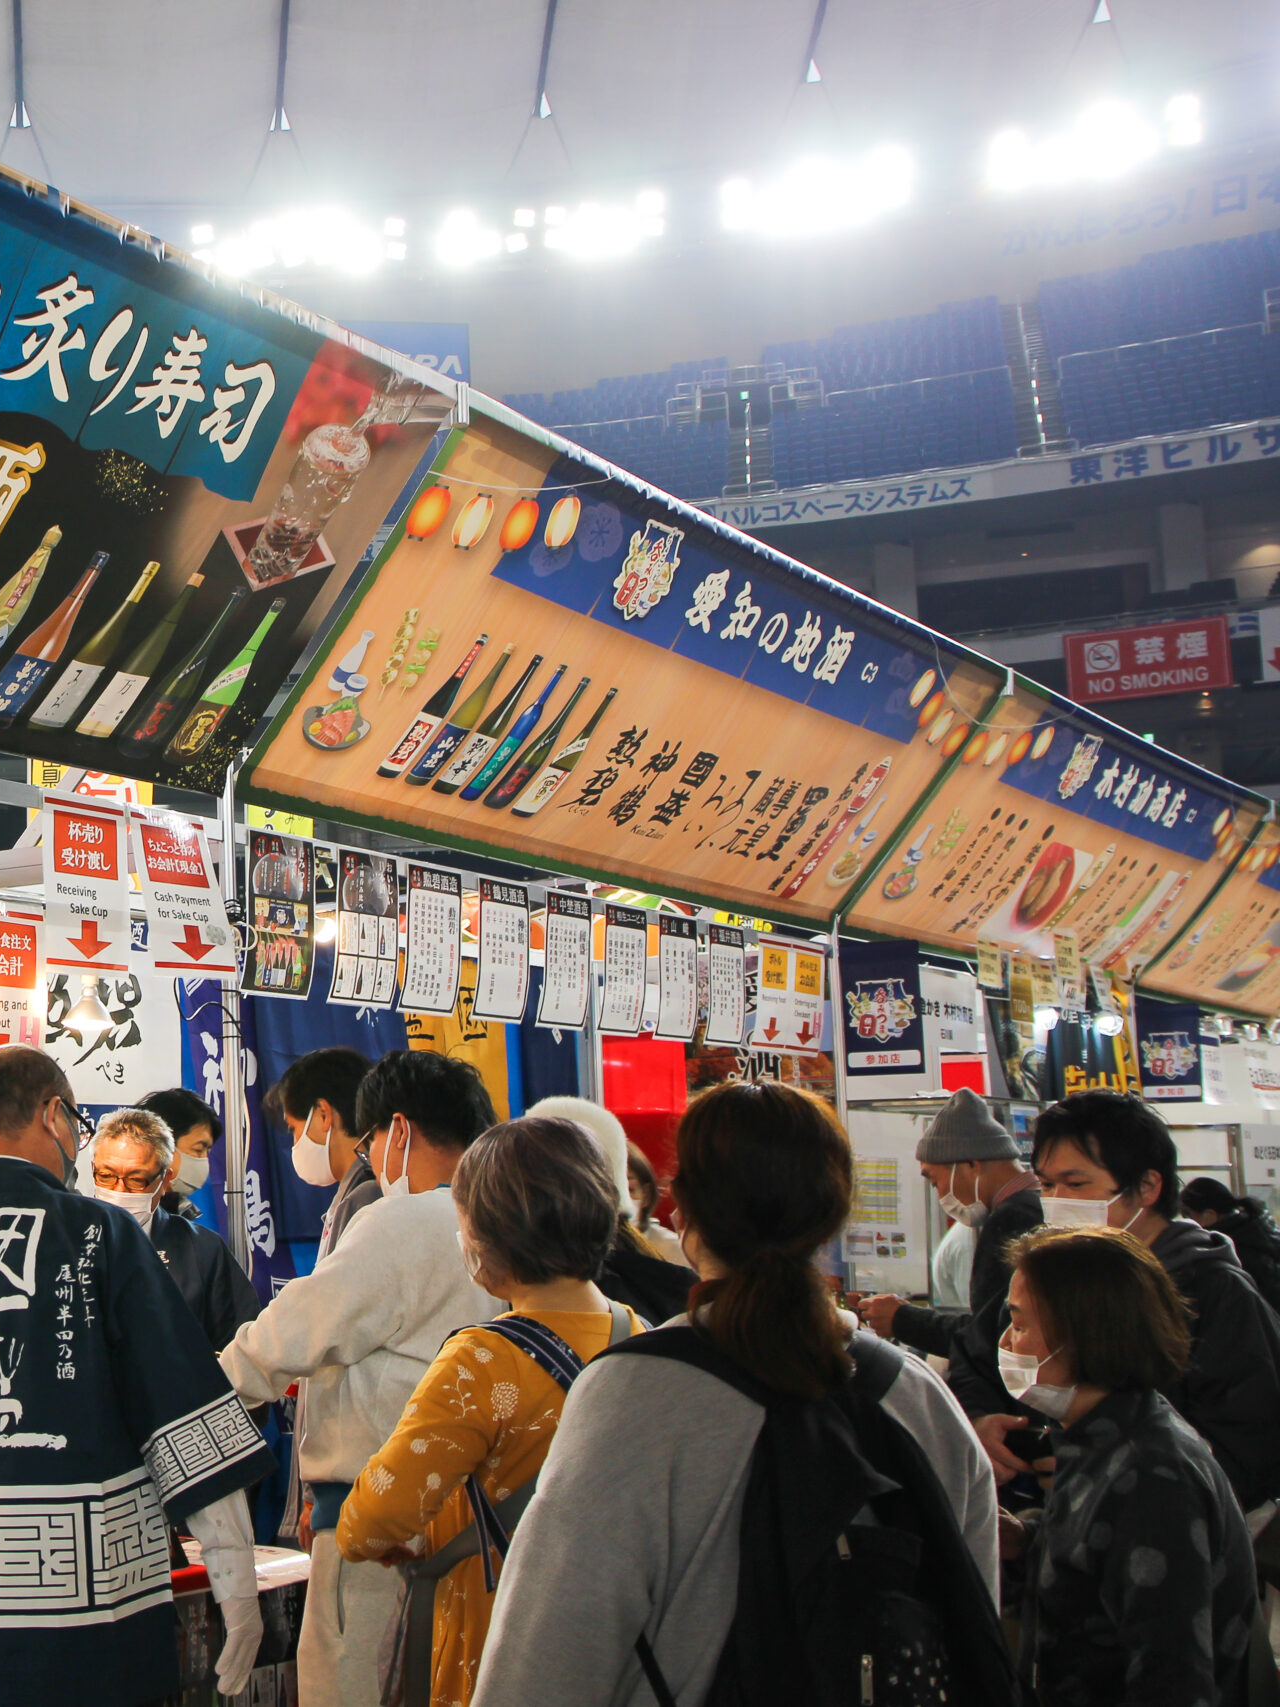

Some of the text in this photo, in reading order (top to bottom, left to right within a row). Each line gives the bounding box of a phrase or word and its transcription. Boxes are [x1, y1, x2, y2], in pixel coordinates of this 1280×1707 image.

[720, 477, 973, 526] パルコスペースシステムズ
[684, 568, 879, 686] 愛知の地酒 C3
[1132, 629, 1209, 666] 禁煙
[1089, 666, 1210, 694] NO SMOKING
[607, 740, 683, 827] 神鶴
[648, 750, 720, 826] 國盛
[67, 820, 104, 843] 杯売り
[60, 849, 112, 871] 受け渡し
[56, 883, 97, 900] Receiving
[154, 892, 211, 908] Cash Payment
[70, 903, 108, 919] Sake Cup
[158, 906, 209, 924] for Sake Cup
[11, 998, 28, 1011] and
[865, 1053, 901, 1065] 参加店
